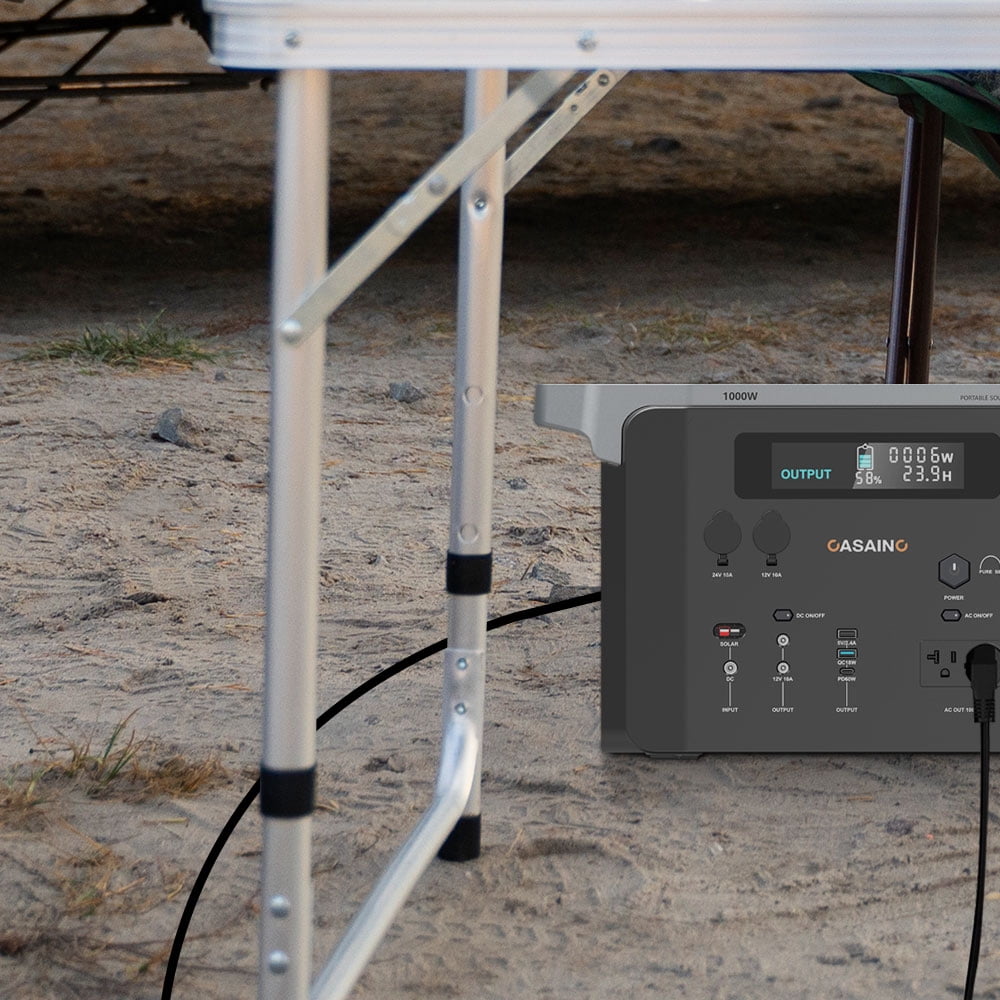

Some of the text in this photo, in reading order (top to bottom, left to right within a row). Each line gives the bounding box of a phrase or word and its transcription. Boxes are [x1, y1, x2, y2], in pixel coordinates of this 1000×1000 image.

[723, 392, 758, 400] 1000W
[780, 469, 832, 480] OUTPUT
[855, 471, 882, 485] 58%
